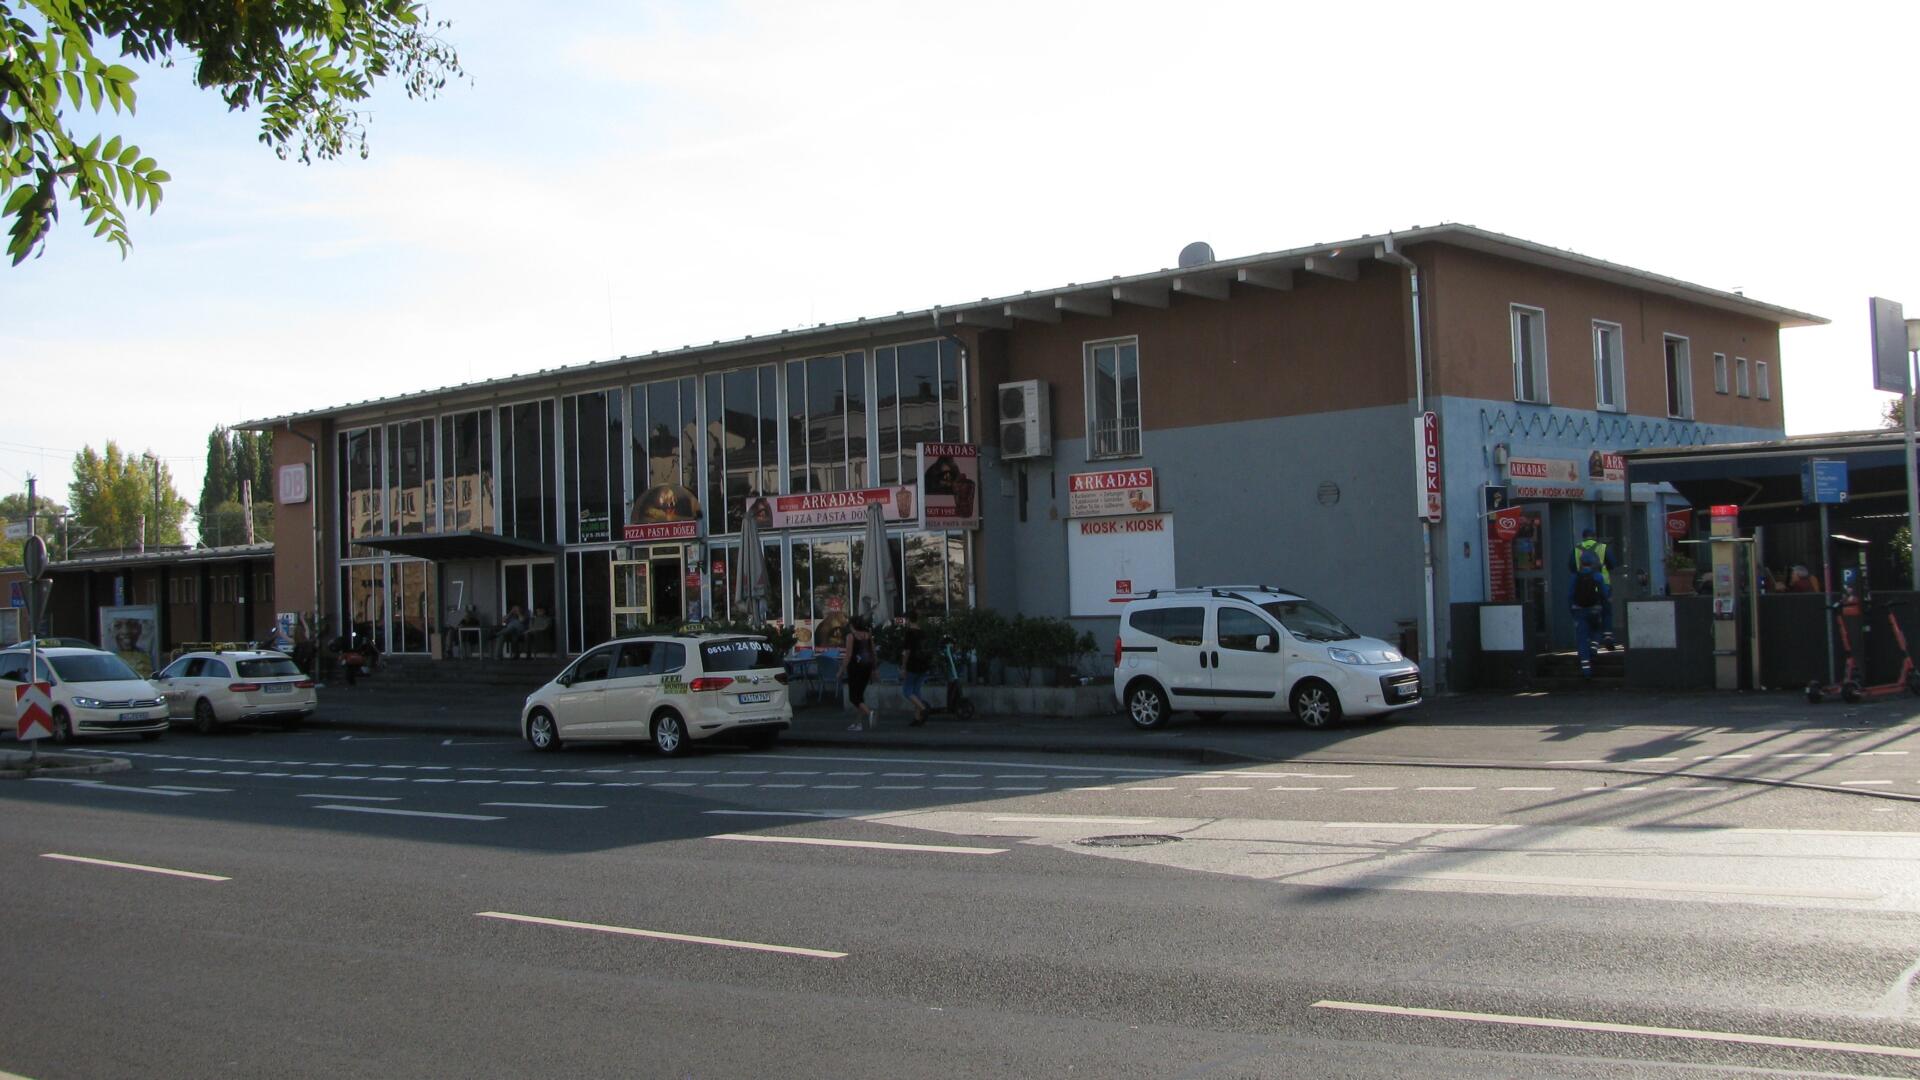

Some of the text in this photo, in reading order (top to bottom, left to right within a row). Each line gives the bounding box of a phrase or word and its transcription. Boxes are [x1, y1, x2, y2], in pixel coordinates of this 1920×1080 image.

[924, 444, 976, 456] ARKADAS
[1425, 415, 1437, 489] KIOSK
[1511, 463, 1546, 476] ARKADAS
[282, 470, 305, 497] DB
[1074, 472, 1148, 490] ARKADAS
[1517, 487, 1538, 497] KIOSK
[1840, 492, 1847, 503] P
[802, 491, 865, 509] ARKADAS
[786, 514, 812, 525] PIZZA
[817, 511, 847, 523] PASTA
[625, 528, 644, 539] PIZZA
[647, 527, 670, 538] PASTA
[1081, 519, 1164, 535] KIOSK KIOSK
[1843, 569, 1852, 582] P
[707, 644, 731, 655] 06134
[735, 641, 748, 651] 24
[750, 641, 762, 651] 00
